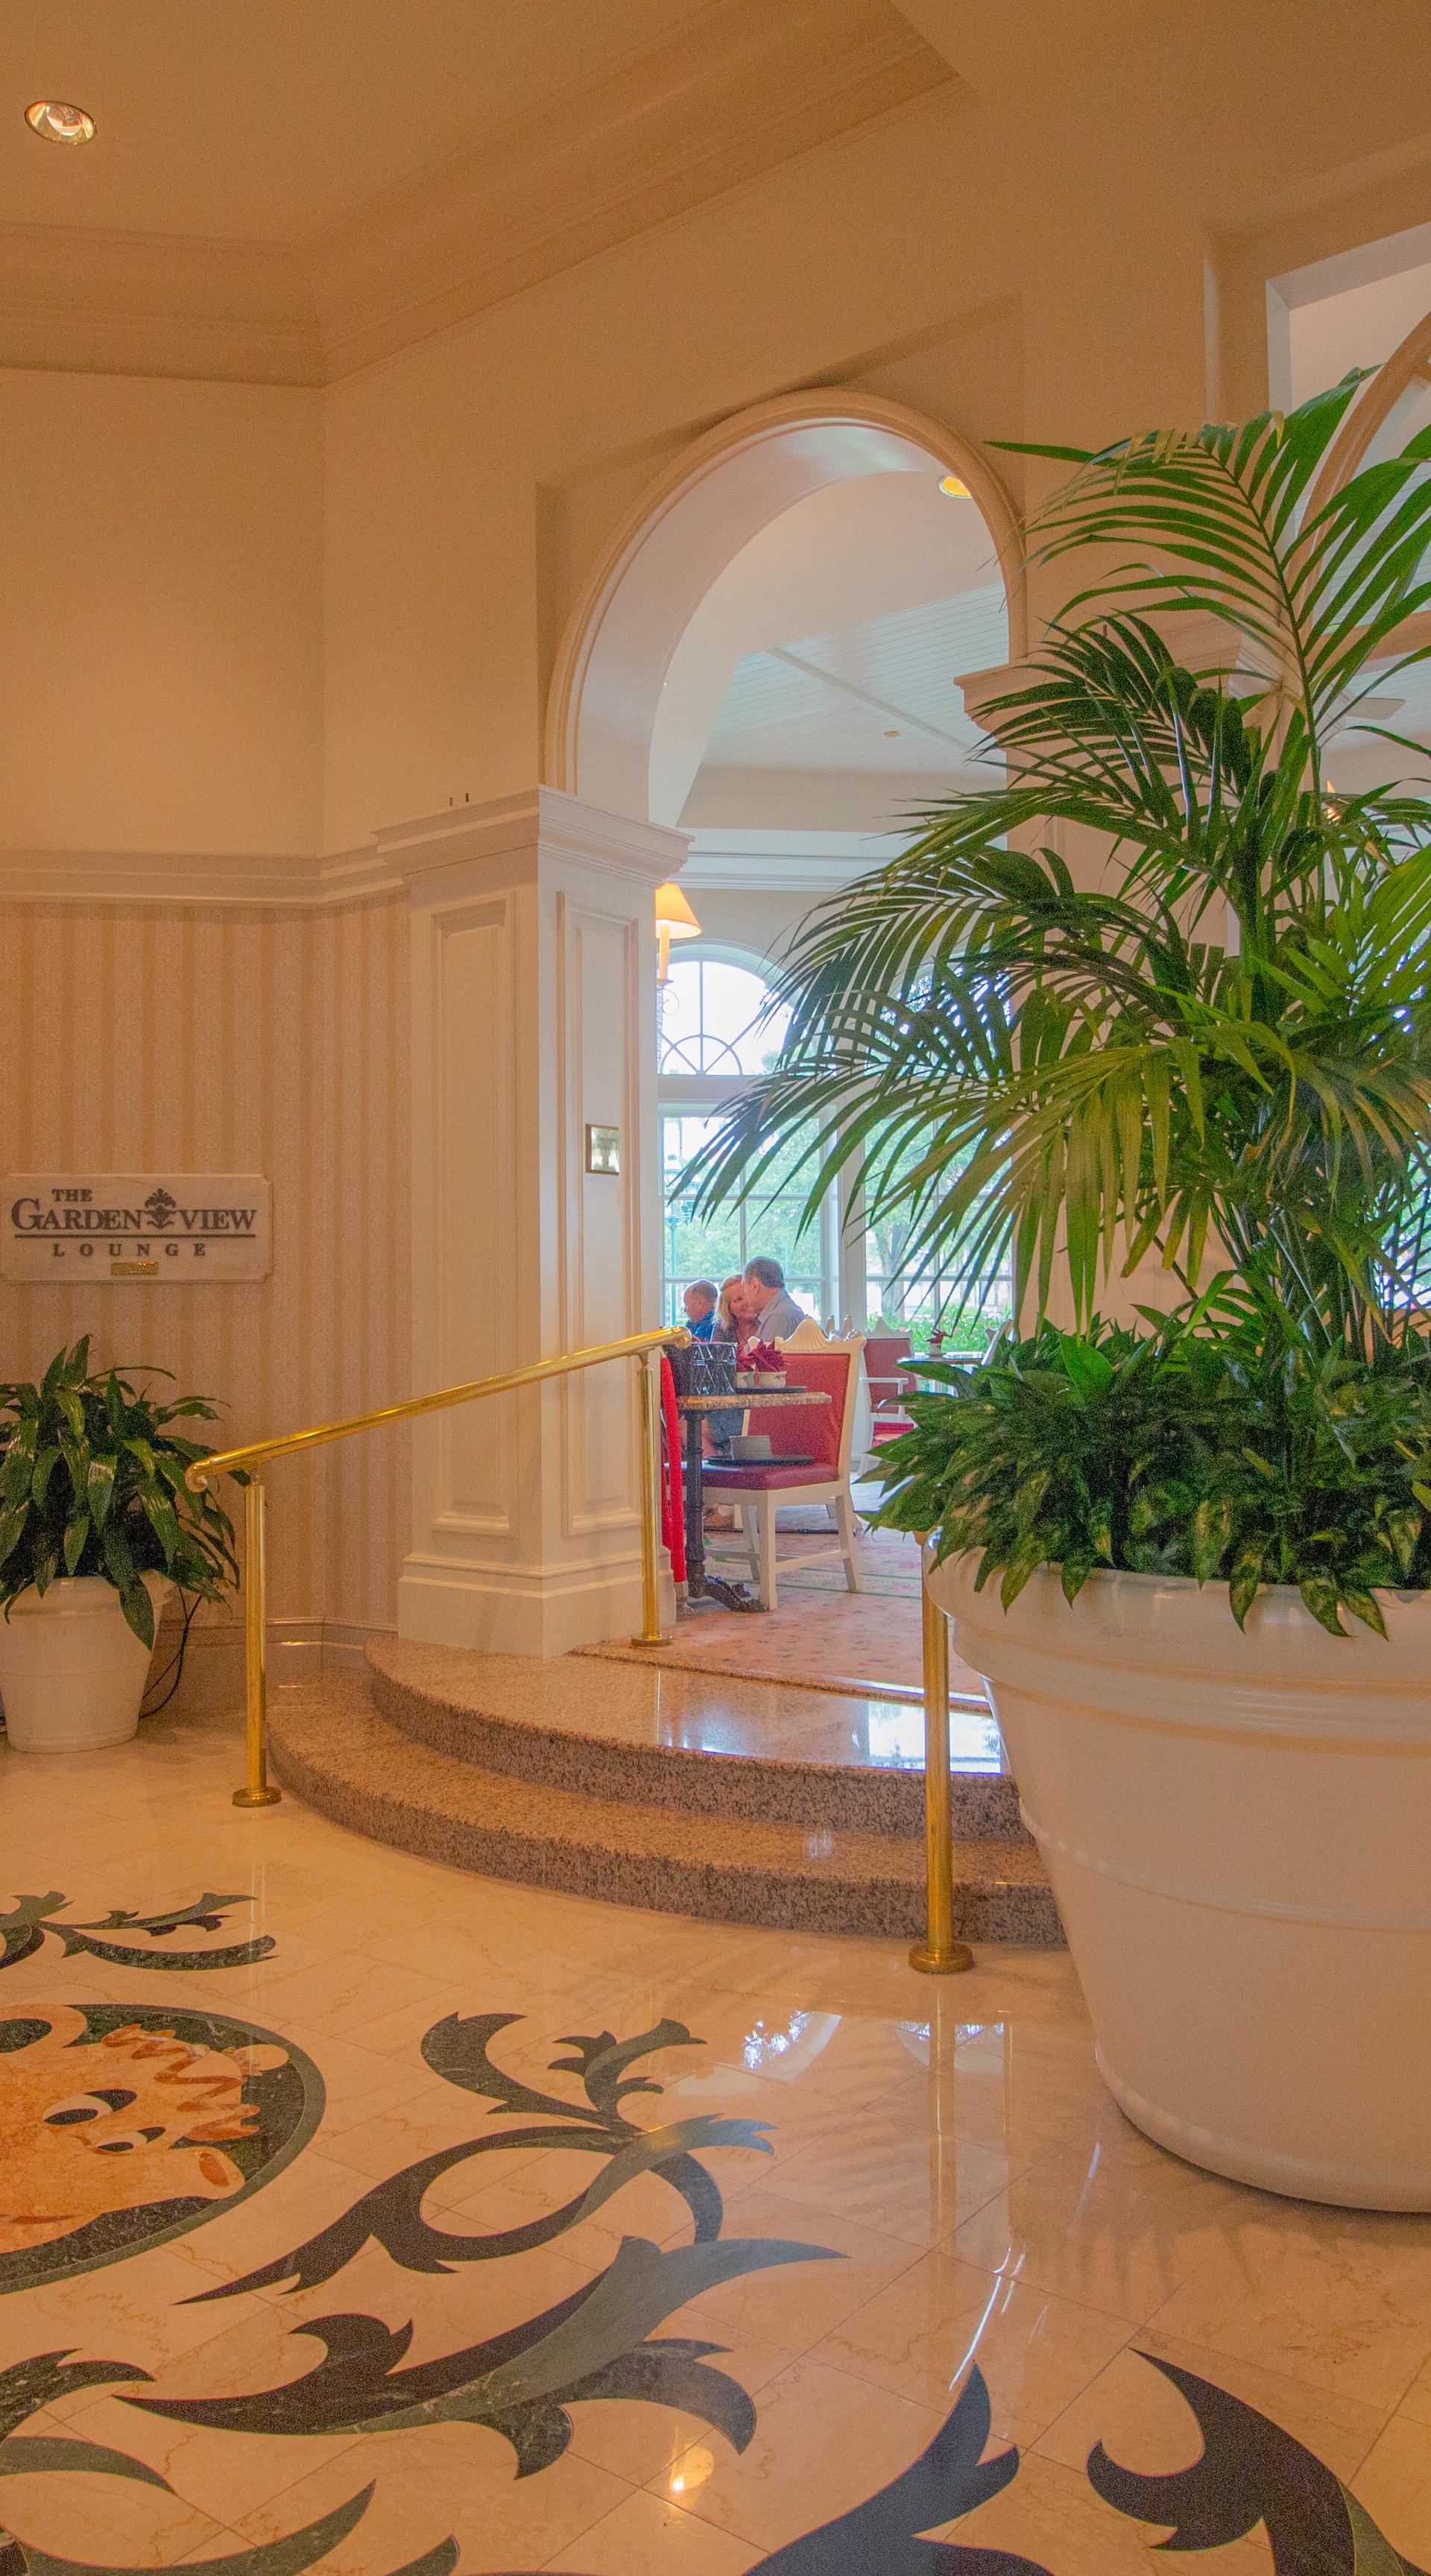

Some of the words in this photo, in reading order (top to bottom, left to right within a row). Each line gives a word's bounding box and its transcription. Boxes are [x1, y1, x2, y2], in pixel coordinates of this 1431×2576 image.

[51, 1189, 92, 1202] THE
[11, 1198, 143, 1230] GARDEN
[178, 1210, 257, 1229] VIEW
[53, 1243, 206, 1257] LOUNGE
